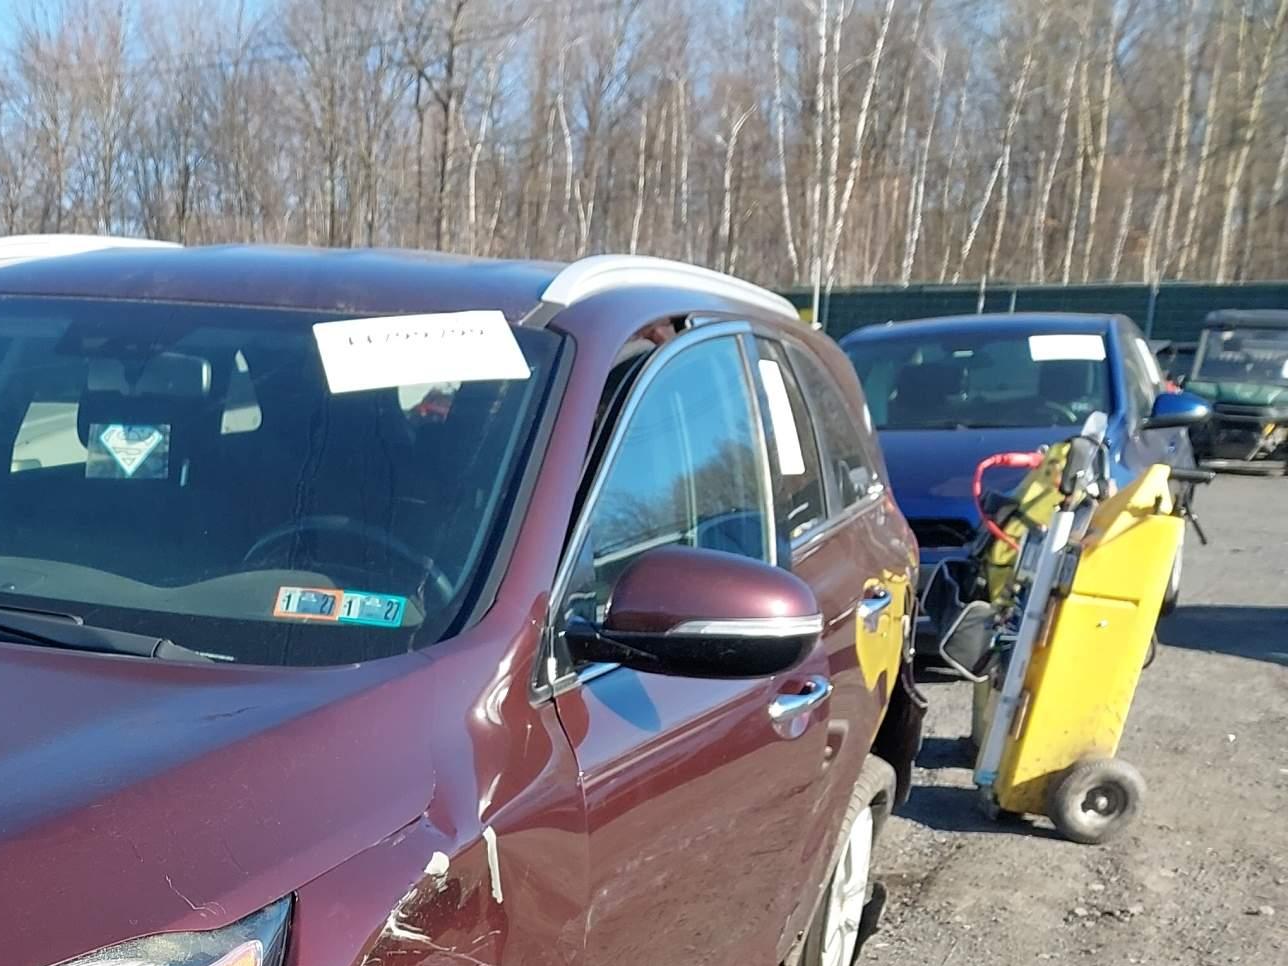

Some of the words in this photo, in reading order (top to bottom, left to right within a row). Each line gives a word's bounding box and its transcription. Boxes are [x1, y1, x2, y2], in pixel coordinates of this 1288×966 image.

[285, 593, 292, 611] 1
[320, 594, 337, 615] 27
[346, 599, 353, 617] 1
[383, 600, 401, 622] 27
